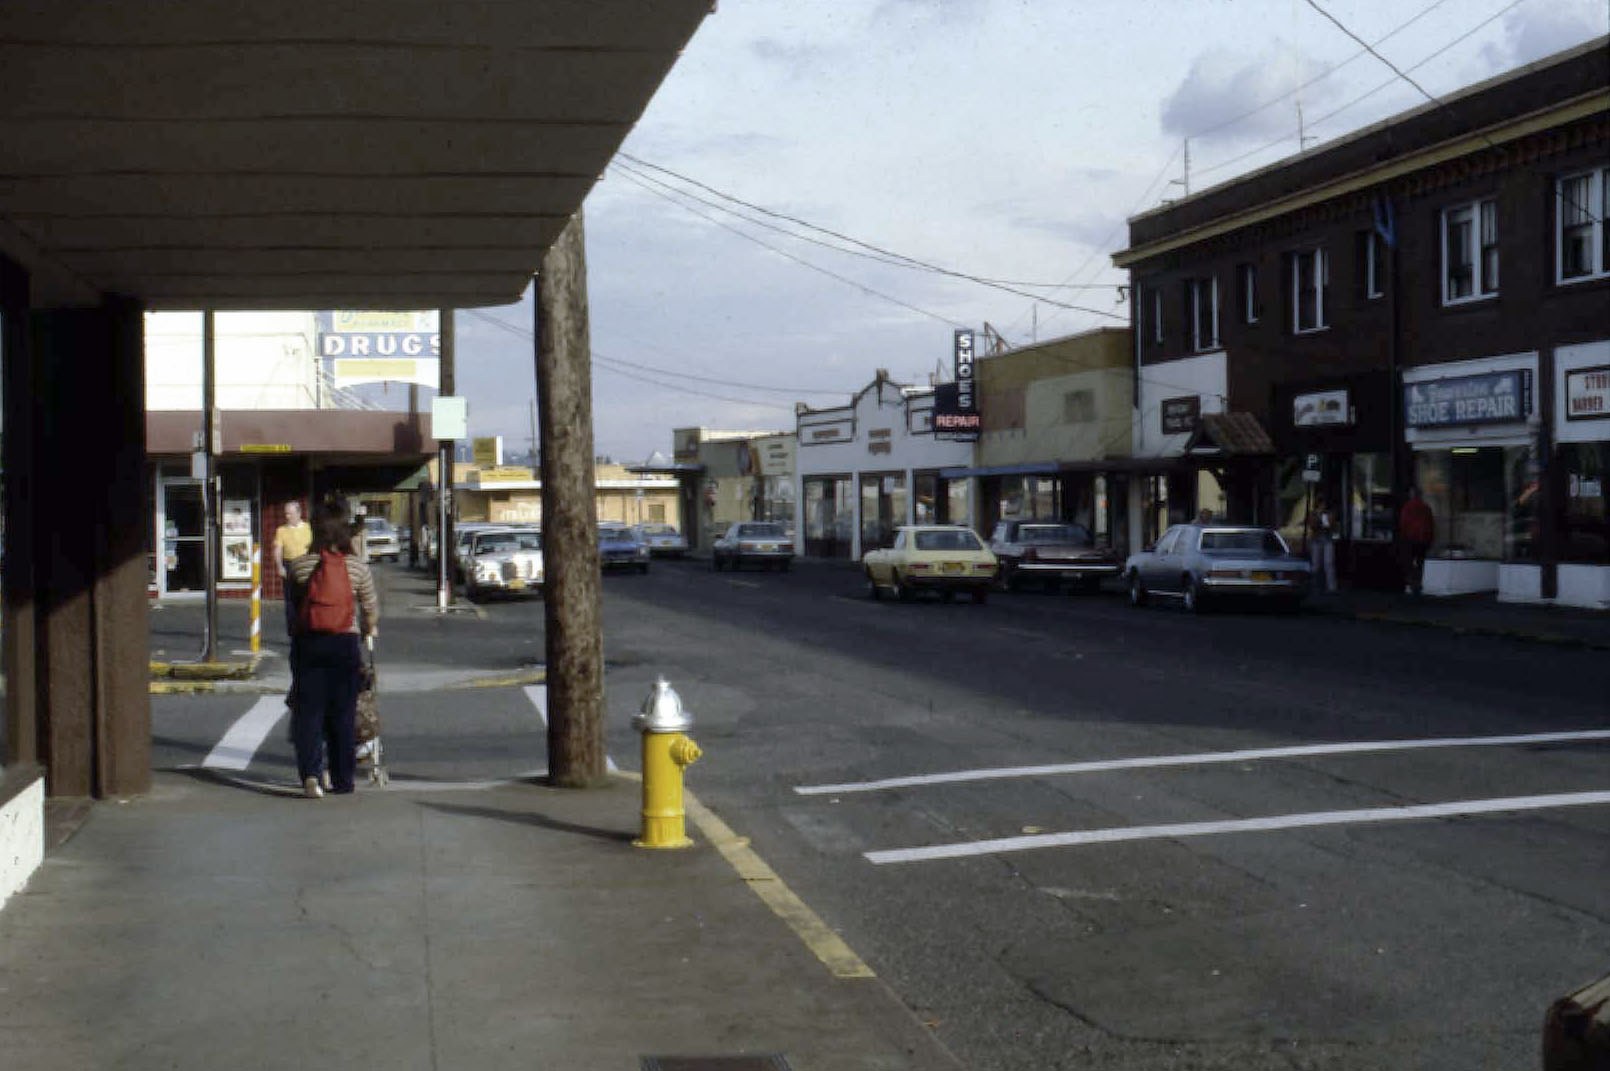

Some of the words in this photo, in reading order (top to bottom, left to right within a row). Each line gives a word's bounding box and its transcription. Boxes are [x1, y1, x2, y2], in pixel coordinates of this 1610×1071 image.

[958, 333, 972, 408] SHOES
[935, 415, 981, 428] REPAIR
[1408, 401, 1450, 424] SHOE
[1455, 394, 1516, 419] REPAIR
